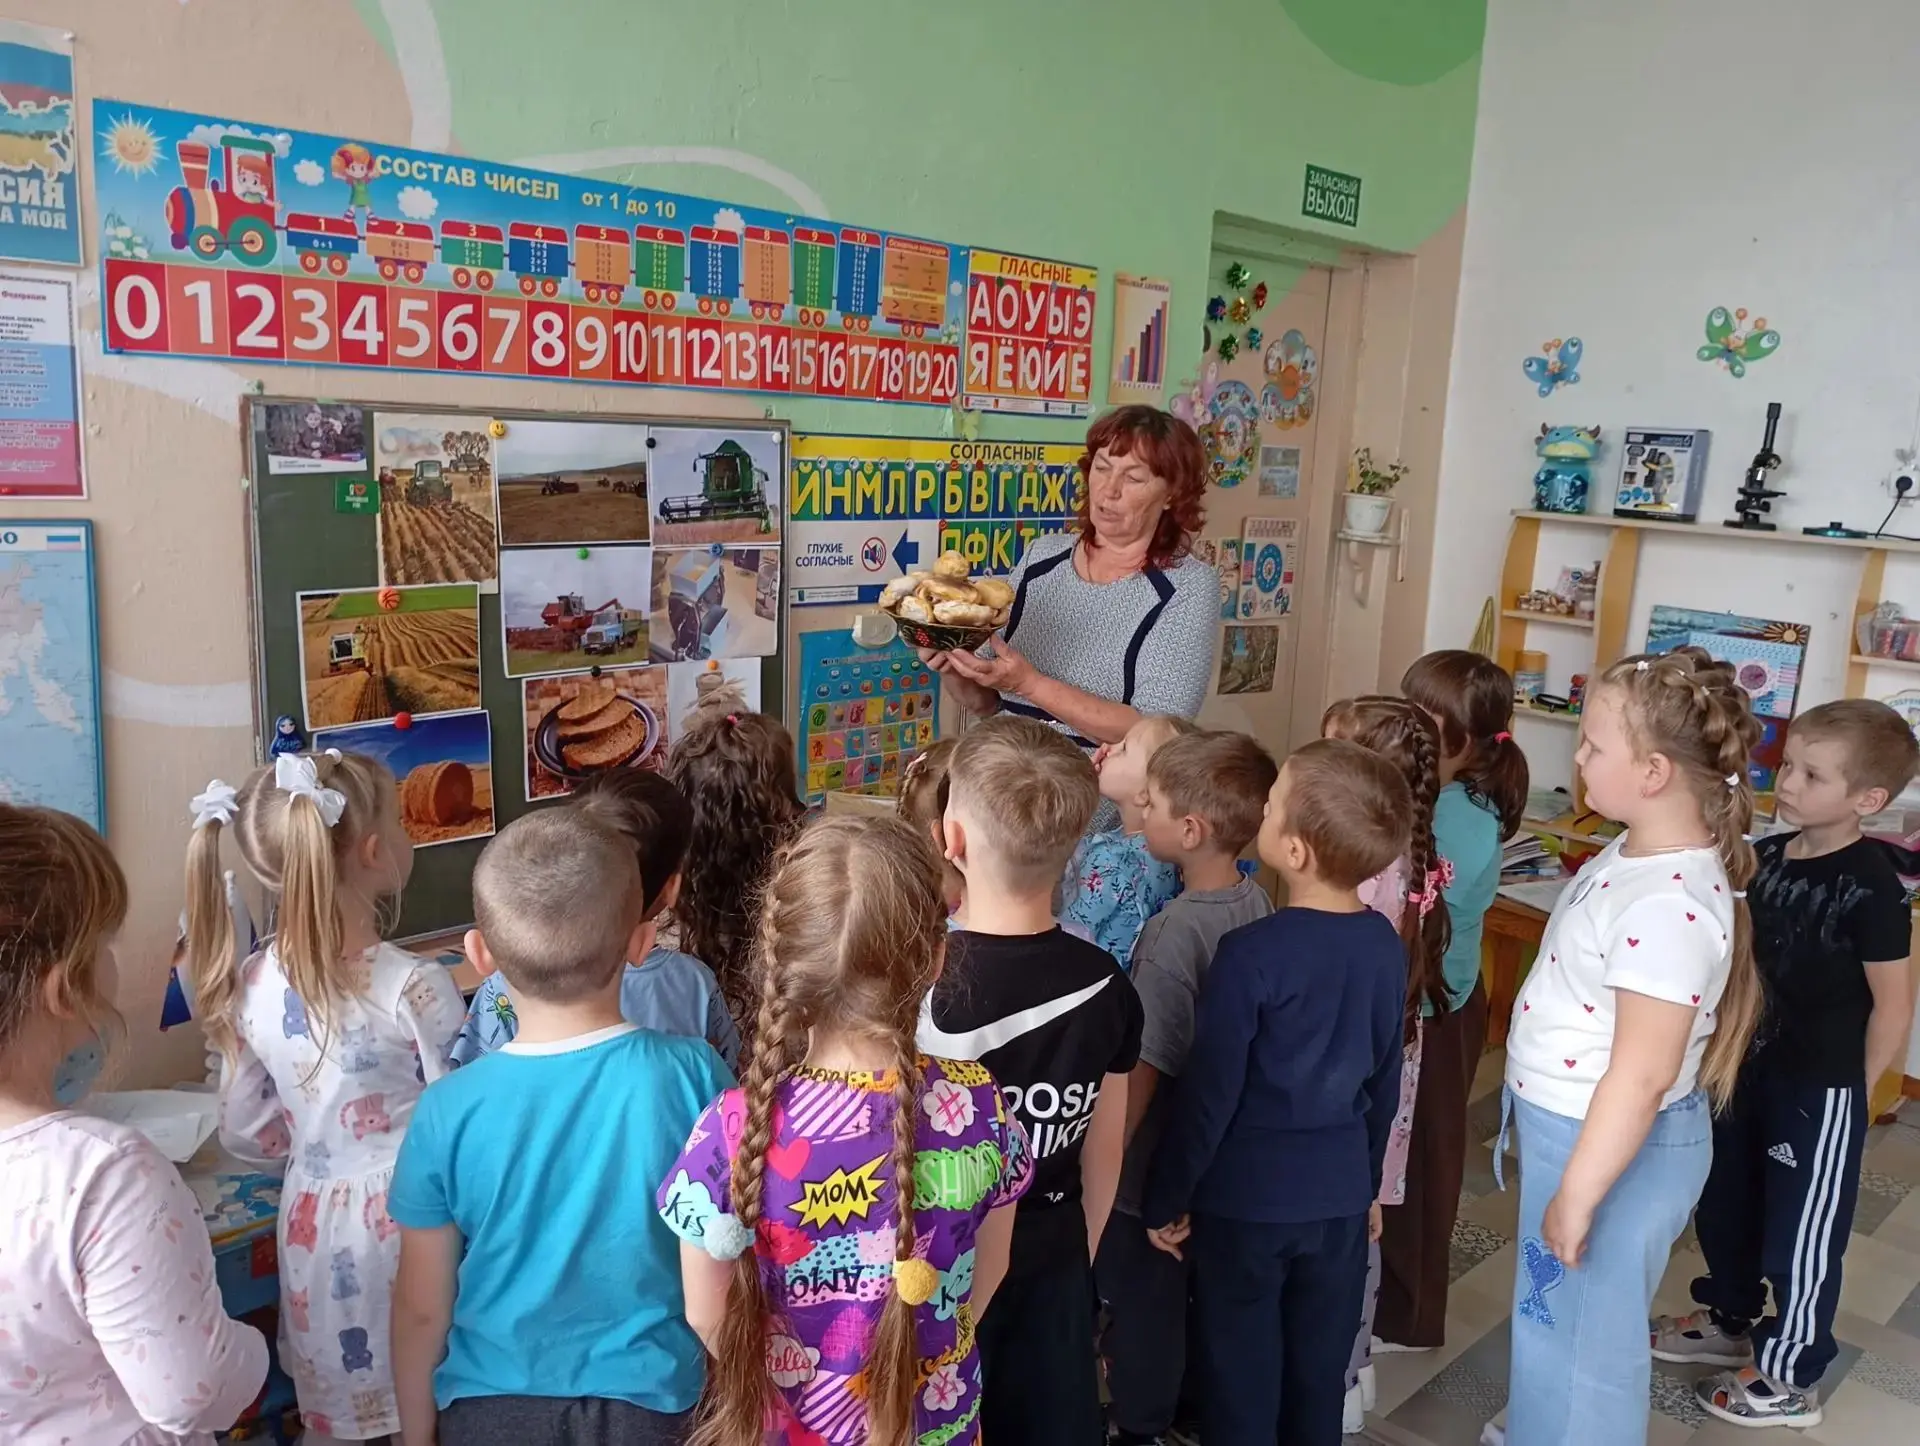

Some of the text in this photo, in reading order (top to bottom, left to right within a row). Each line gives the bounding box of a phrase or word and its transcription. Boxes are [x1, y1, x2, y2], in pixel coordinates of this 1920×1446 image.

[376, 154, 677, 219] СОСТАВ ЧИСЕЛ от 1 до 10
[1309, 170, 1358, 194] ЗАПАСНЫЙ
[1306, 186, 1355, 223] ВЫХОД
[22, 209, 67, 229] МОЯ
[318, 218, 325, 231] 1
[395, 223, 404, 235] 2
[468, 224, 477, 237] 3
[535, 226, 543, 239] 4
[600, 227, 607, 240] 5
[656, 228, 664, 240] 6
[712, 229, 719, 241] 7
[811, 231, 818, 242] 9
[856, 232, 867, 243] 10
[1000, 257, 1072, 283] ГЛАСНЫЕ
[114, 275, 958, 397] 0 1 2 3 4 5 6 7 8 9 10 11 12 13 14 15 16 17 18 19 20
[950, 443, 1045, 460] СОГЛАСНЫЕ
[795, 555, 854, 567] СОГЛАСНЫЕ
[807, 543, 843, 554] ГЛУХИЕ
[808, 1175, 869, 1214] MOM
